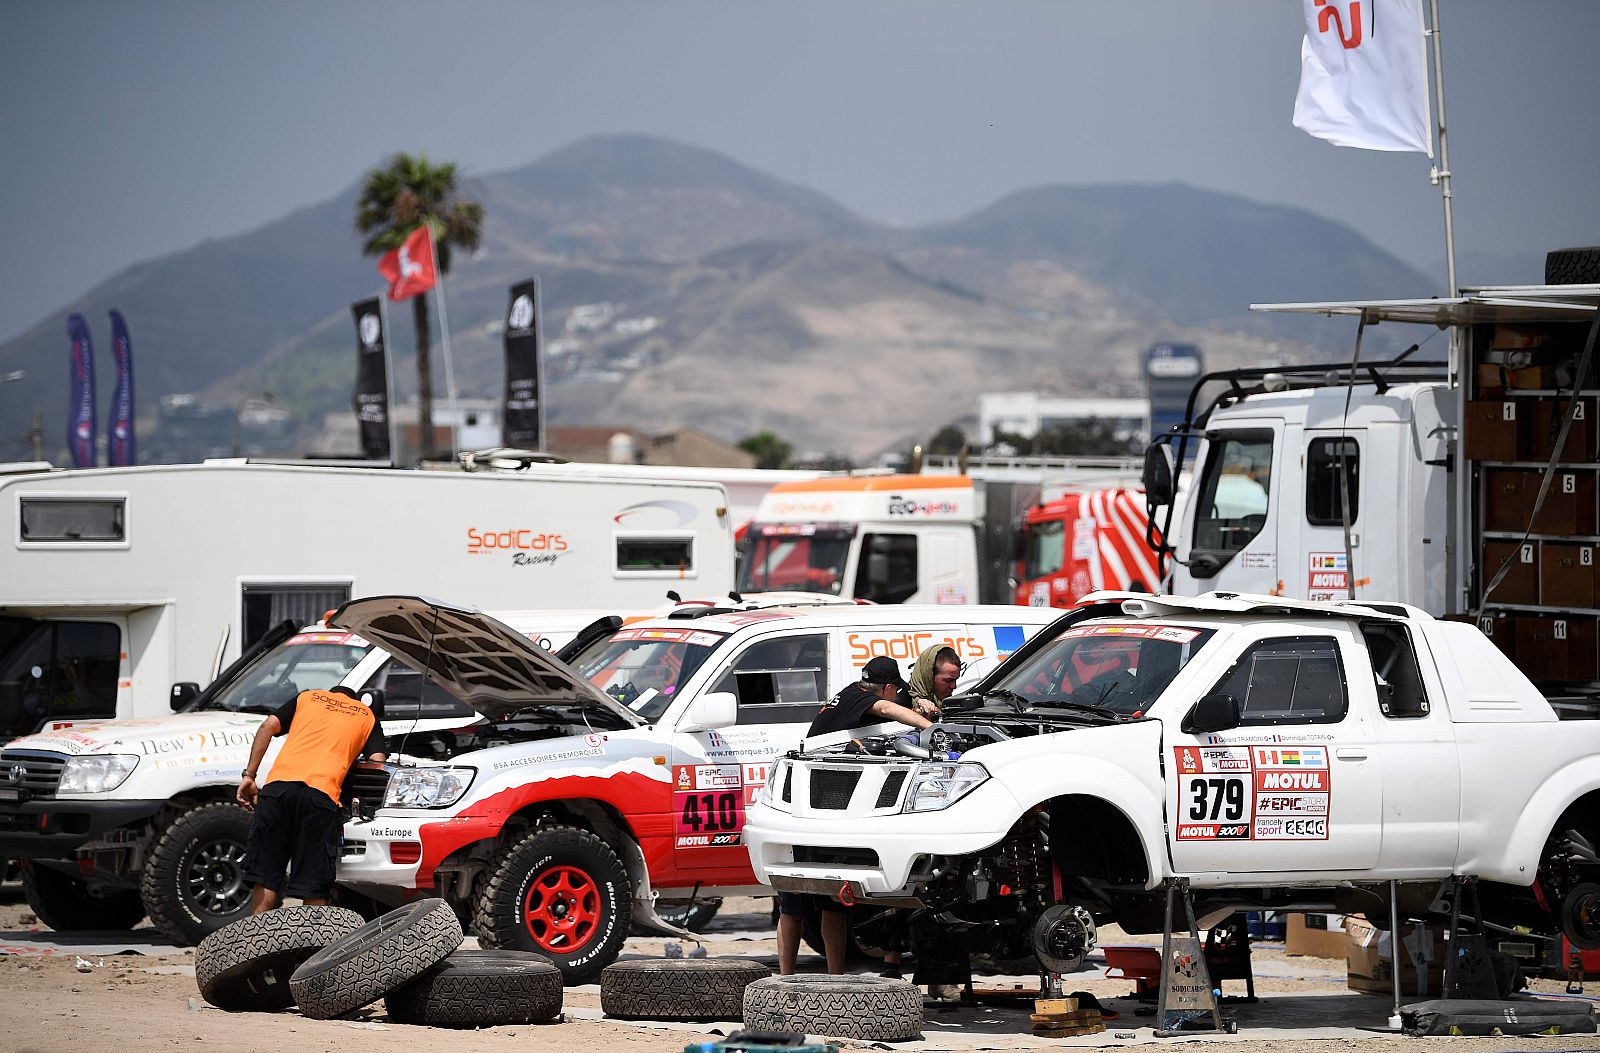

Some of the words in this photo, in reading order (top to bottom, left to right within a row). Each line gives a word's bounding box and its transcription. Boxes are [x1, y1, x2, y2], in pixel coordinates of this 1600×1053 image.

[1505, 405, 1511, 419] 1
[1574, 404, 1582, 418] 2
[1566, 477, 1572, 491] 5
[467, 528, 567, 550] SodiCars
[1524, 547, 1531, 560] 7
[1583, 549, 1590, 563] 8
[1312, 574, 1345, 587] MOTUL
[1483, 619, 1492, 633] 10
[1554, 622, 1565, 637] 11
[493, 762, 508, 770] BSA
[510, 753, 558, 767] ACCESSOIRES
[558, 748, 603, 760] REMORQUES
[1220, 760, 1248, 768] MOTUL
[1263, 773, 1322, 789] MOTUL
[1189, 778, 1244, 821] 379
[682, 793, 737, 831] 410
[370, 827, 383, 836] Vax
[385, 827, 412, 838] Europe
[1180, 827, 1216, 837] MOTUL
[1218, 825, 1248, 836] 300V
[1257, 825, 1282, 836] sport
[677, 836, 709, 846] MOTUL
[712, 834, 740, 844] 300V
